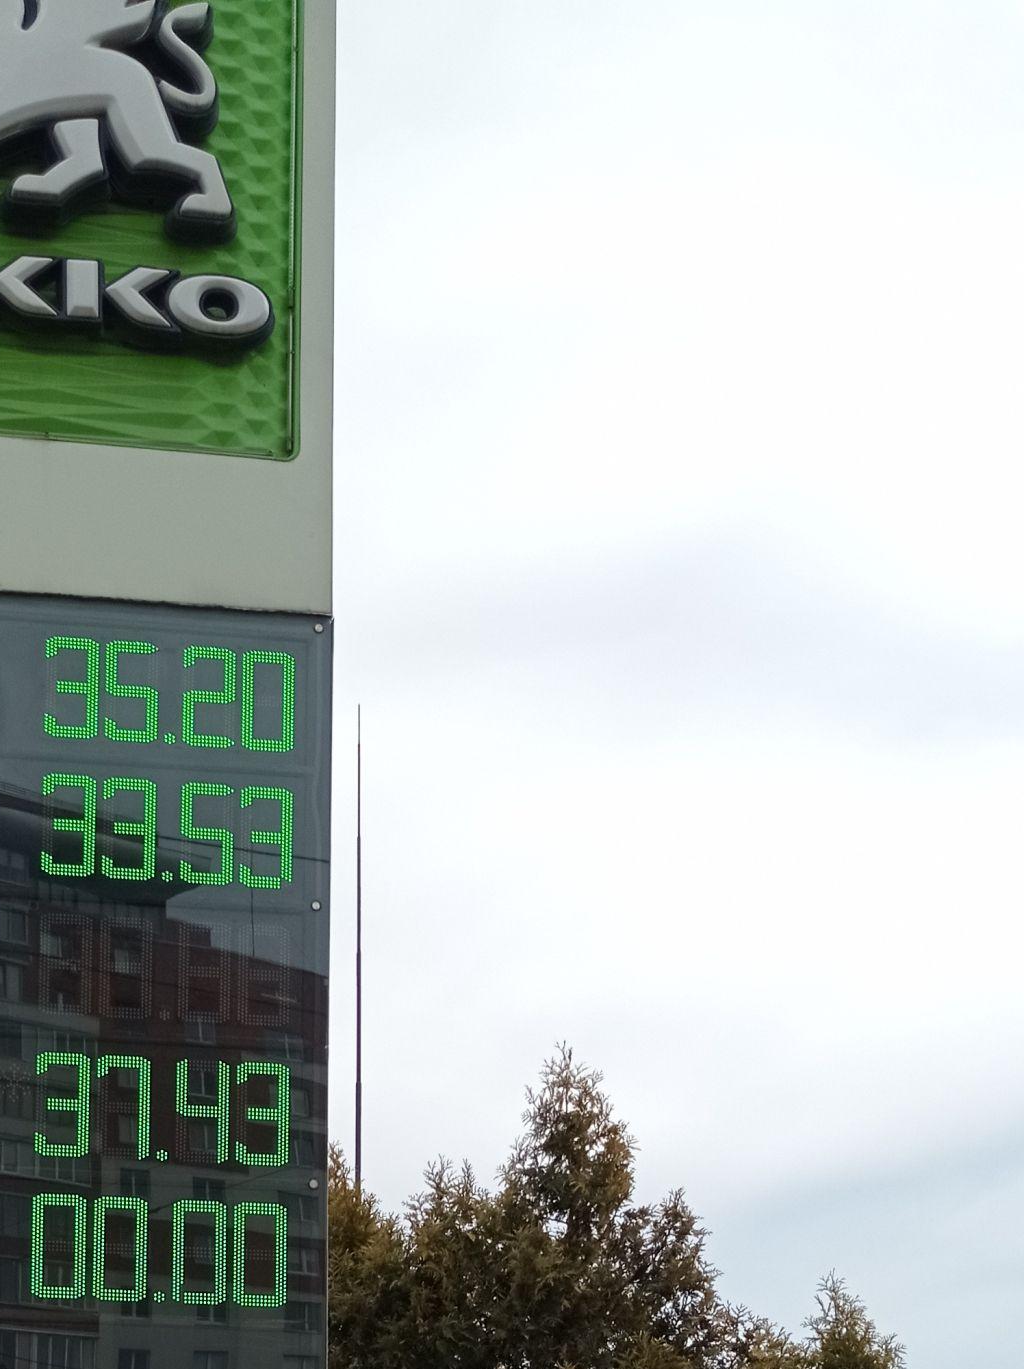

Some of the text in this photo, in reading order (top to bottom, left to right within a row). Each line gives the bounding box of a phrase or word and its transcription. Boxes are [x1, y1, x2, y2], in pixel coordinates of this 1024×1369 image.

[43, 636, 295, 752] 35.20
[41, 772, 294, 889] 33.53
[35, 1051, 291, 1166] 37.43
[31, 1193, 288, 1307] 00.00
